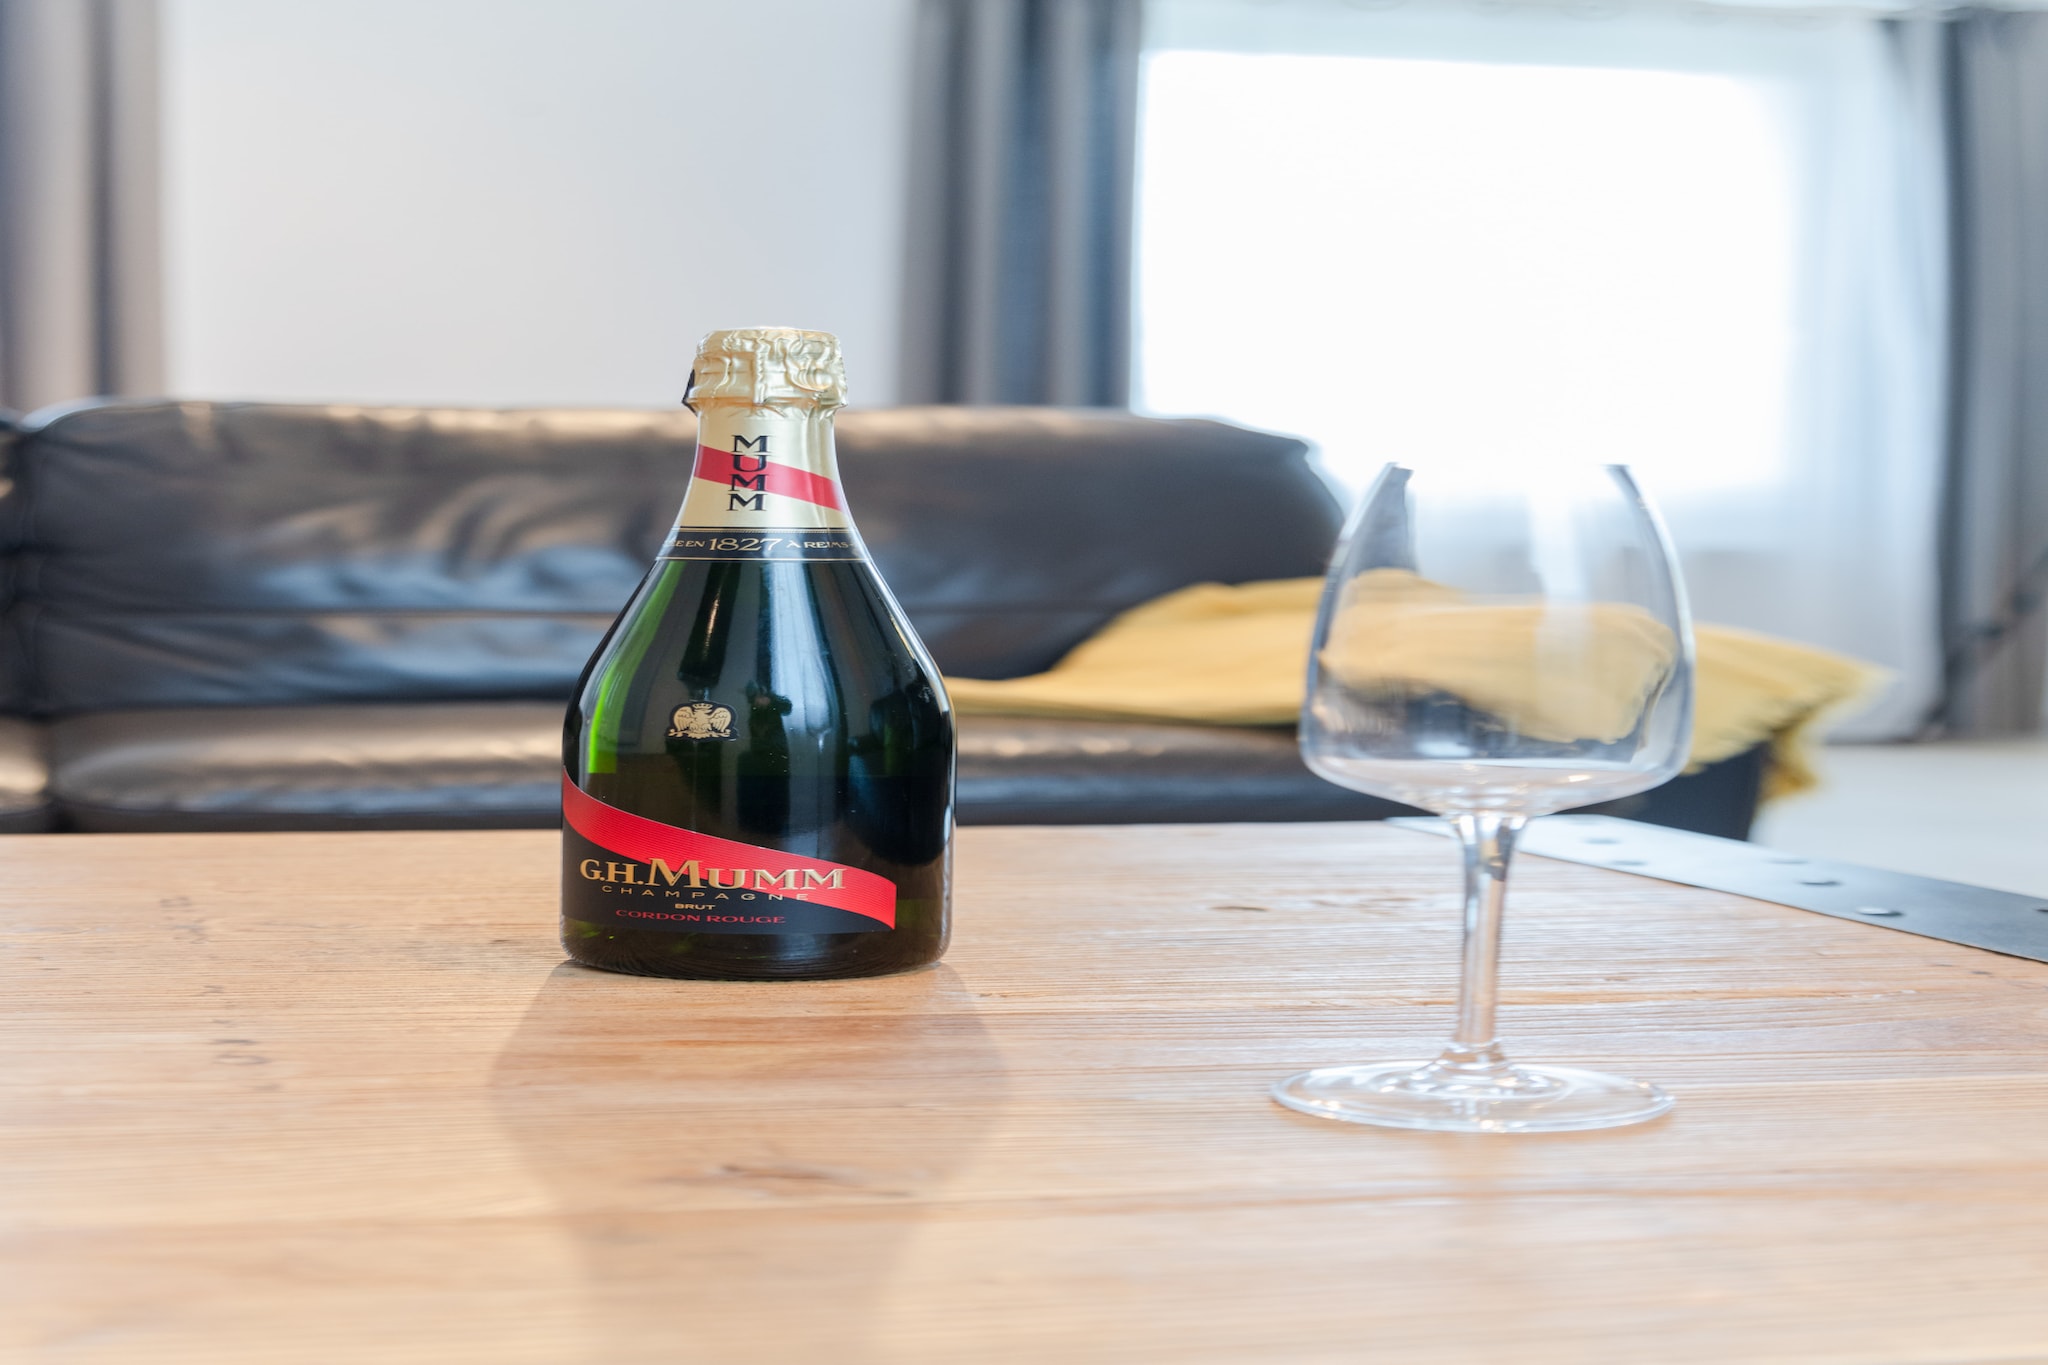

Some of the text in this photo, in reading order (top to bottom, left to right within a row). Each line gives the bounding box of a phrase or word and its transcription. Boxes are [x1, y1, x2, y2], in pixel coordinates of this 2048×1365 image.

[726, 434, 774, 511] MUMM
[709, 538, 783, 551] 1827
[601, 885, 808, 901] CHAMPAGNE
[674, 903, 716, 911] BRUT
[615, 909, 786, 924] CORDON ROUGE
